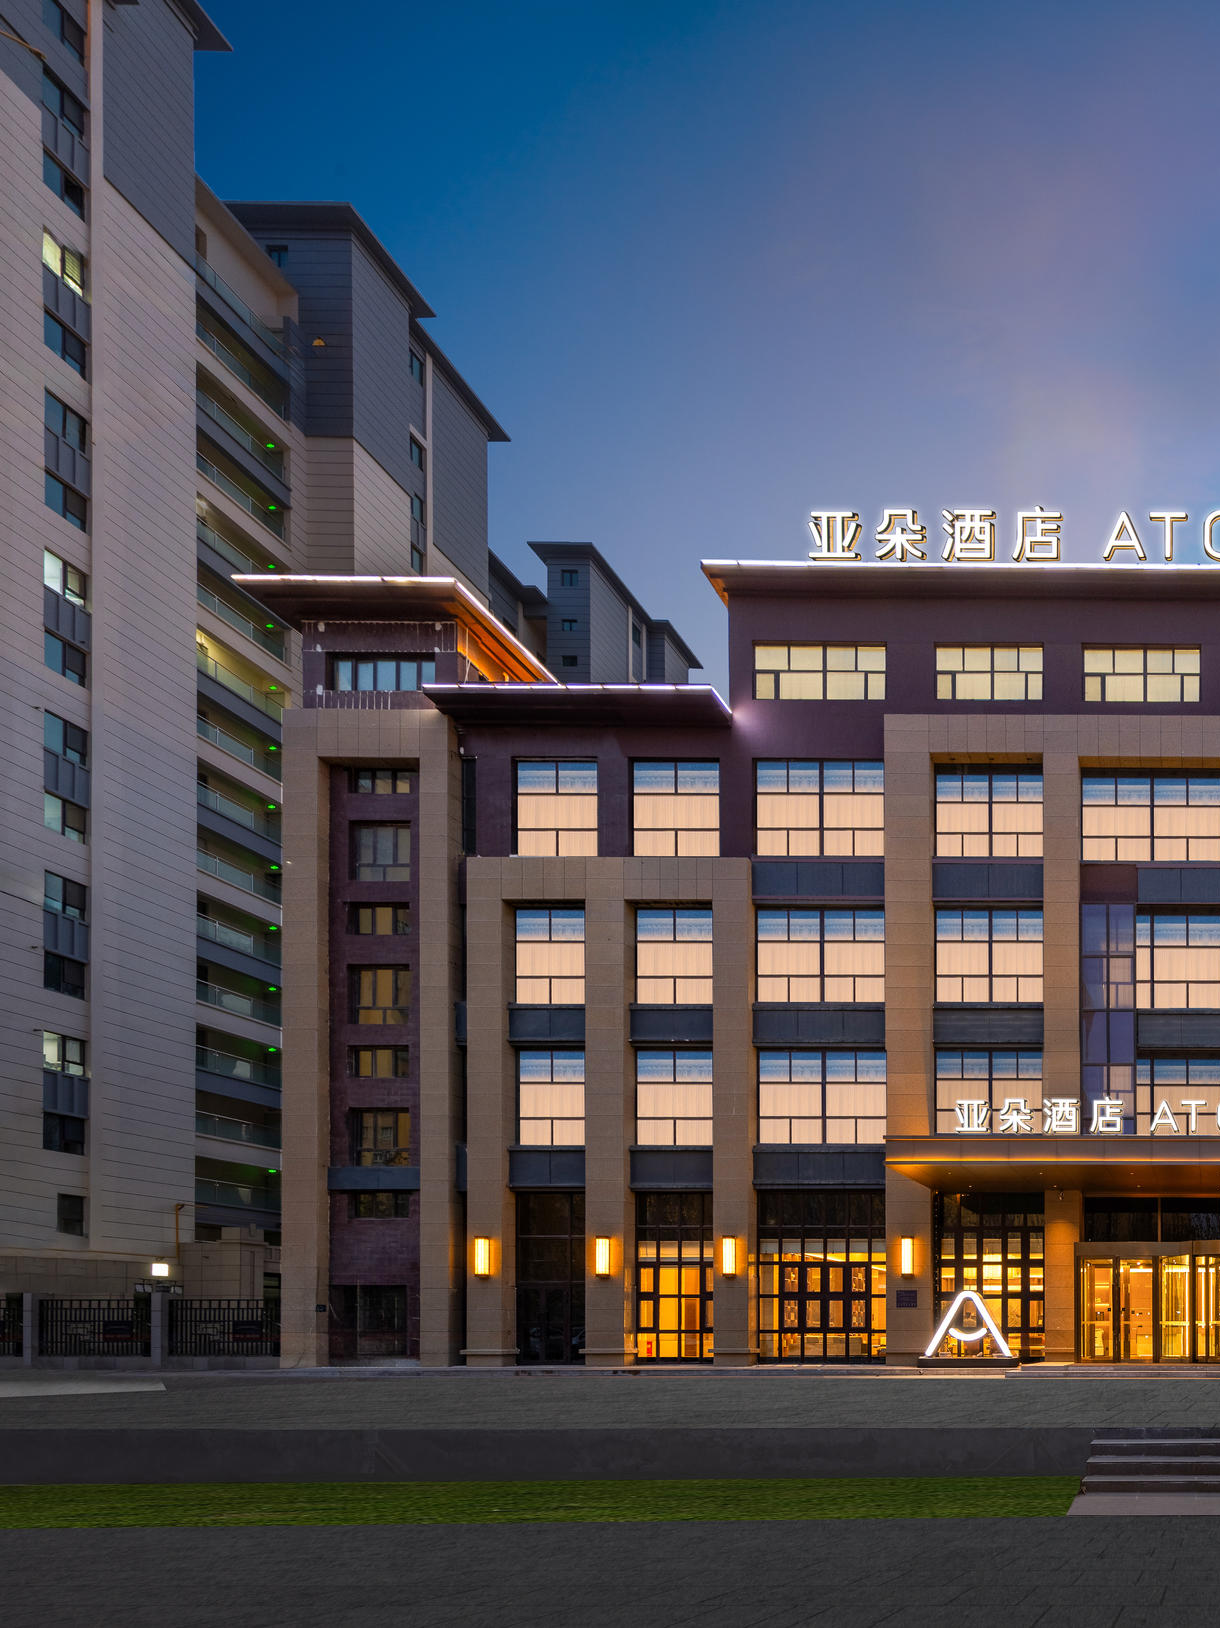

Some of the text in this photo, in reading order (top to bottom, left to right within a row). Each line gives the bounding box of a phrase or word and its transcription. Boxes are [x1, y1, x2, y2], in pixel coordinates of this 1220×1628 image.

[808, 506, 1064, 562] 亚朵酒店
[954, 1097, 1124, 1134] 亚朵酒店
